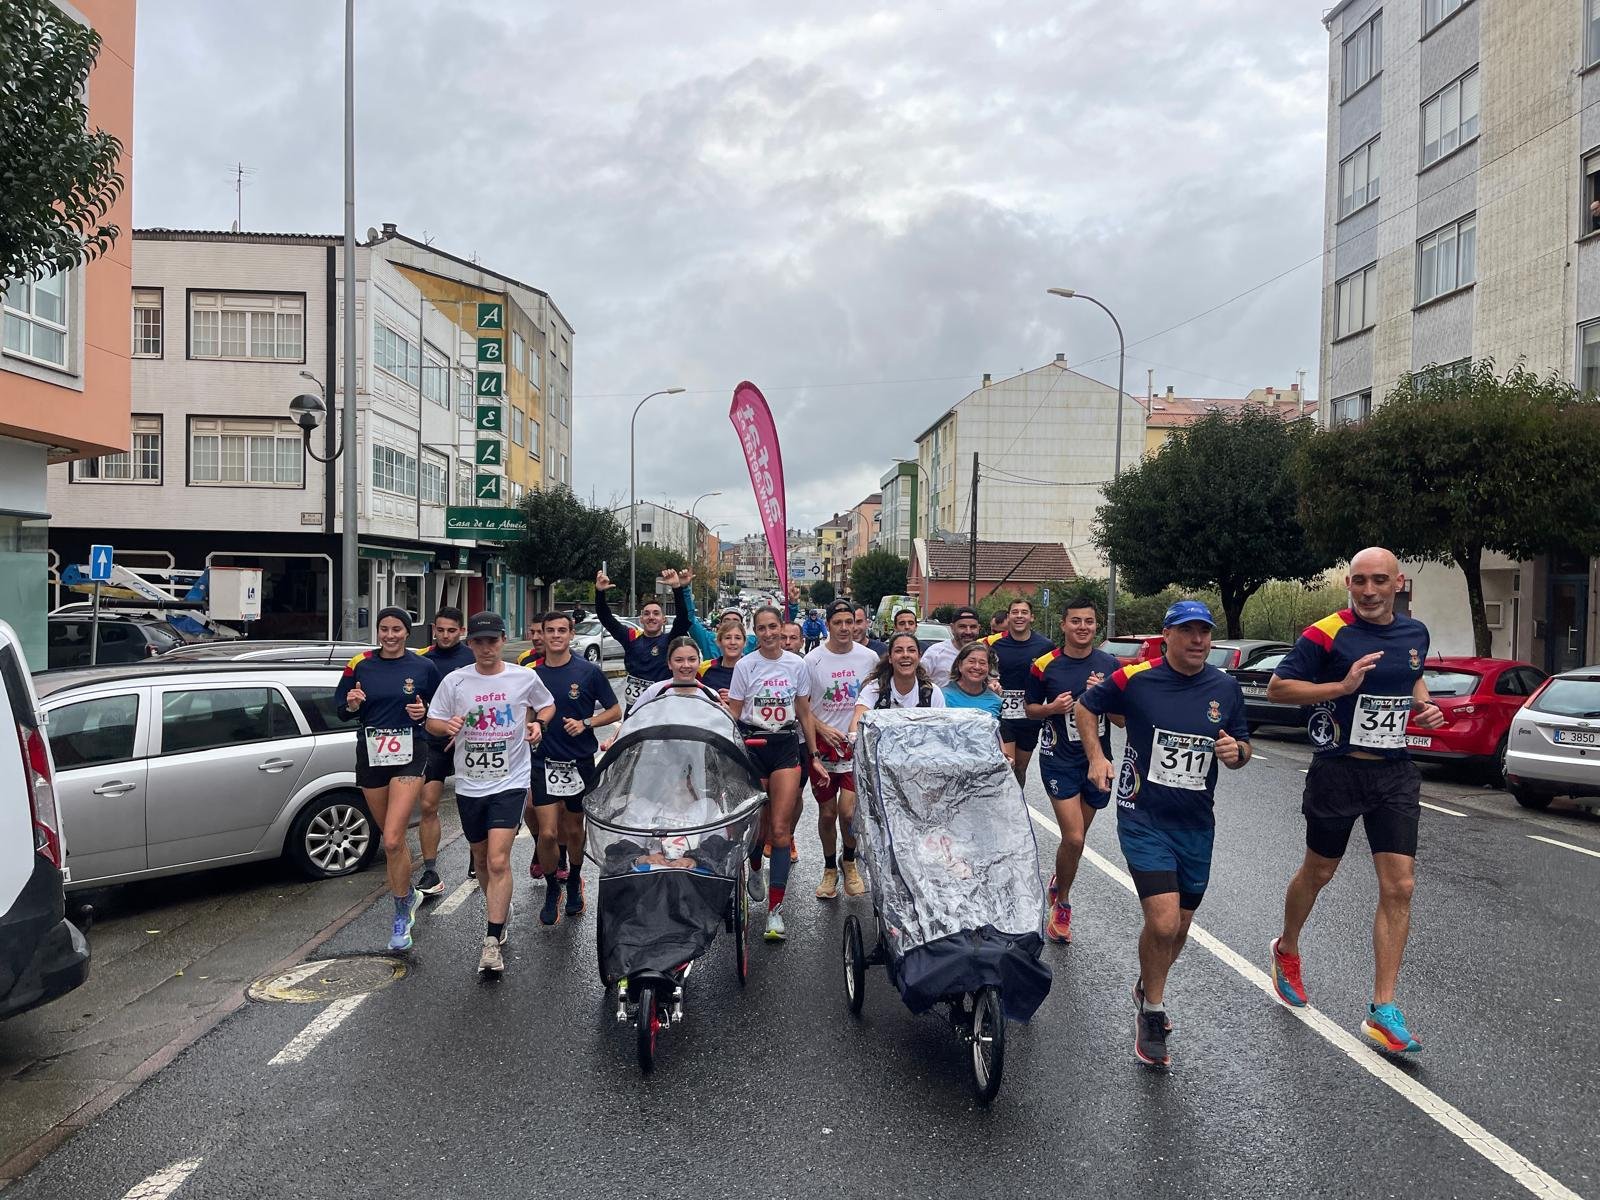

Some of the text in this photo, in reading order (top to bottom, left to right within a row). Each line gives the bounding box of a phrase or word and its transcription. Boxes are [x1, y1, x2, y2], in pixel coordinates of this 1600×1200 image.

[478, 306, 500, 497] ABUELA
[448, 517, 470, 527] Casa
[473, 518, 483, 527] de
[497, 520, 527, 530] Abuela
[831, 669, 856, 678] aefat
[763, 678, 788, 686] aefat
[475, 692, 507, 702] aefat
[760, 706, 787, 721] 90
[1360, 710, 1406, 732] 341
[1168, 735, 1191, 744] VOLTA
[1412, 736, 1429, 746] GHK
[1560, 731, 1595, 743] C 3850
[375, 736, 401, 753] 76
[465, 752, 505, 768] 645
[1160, 746, 1206, 773] 311
